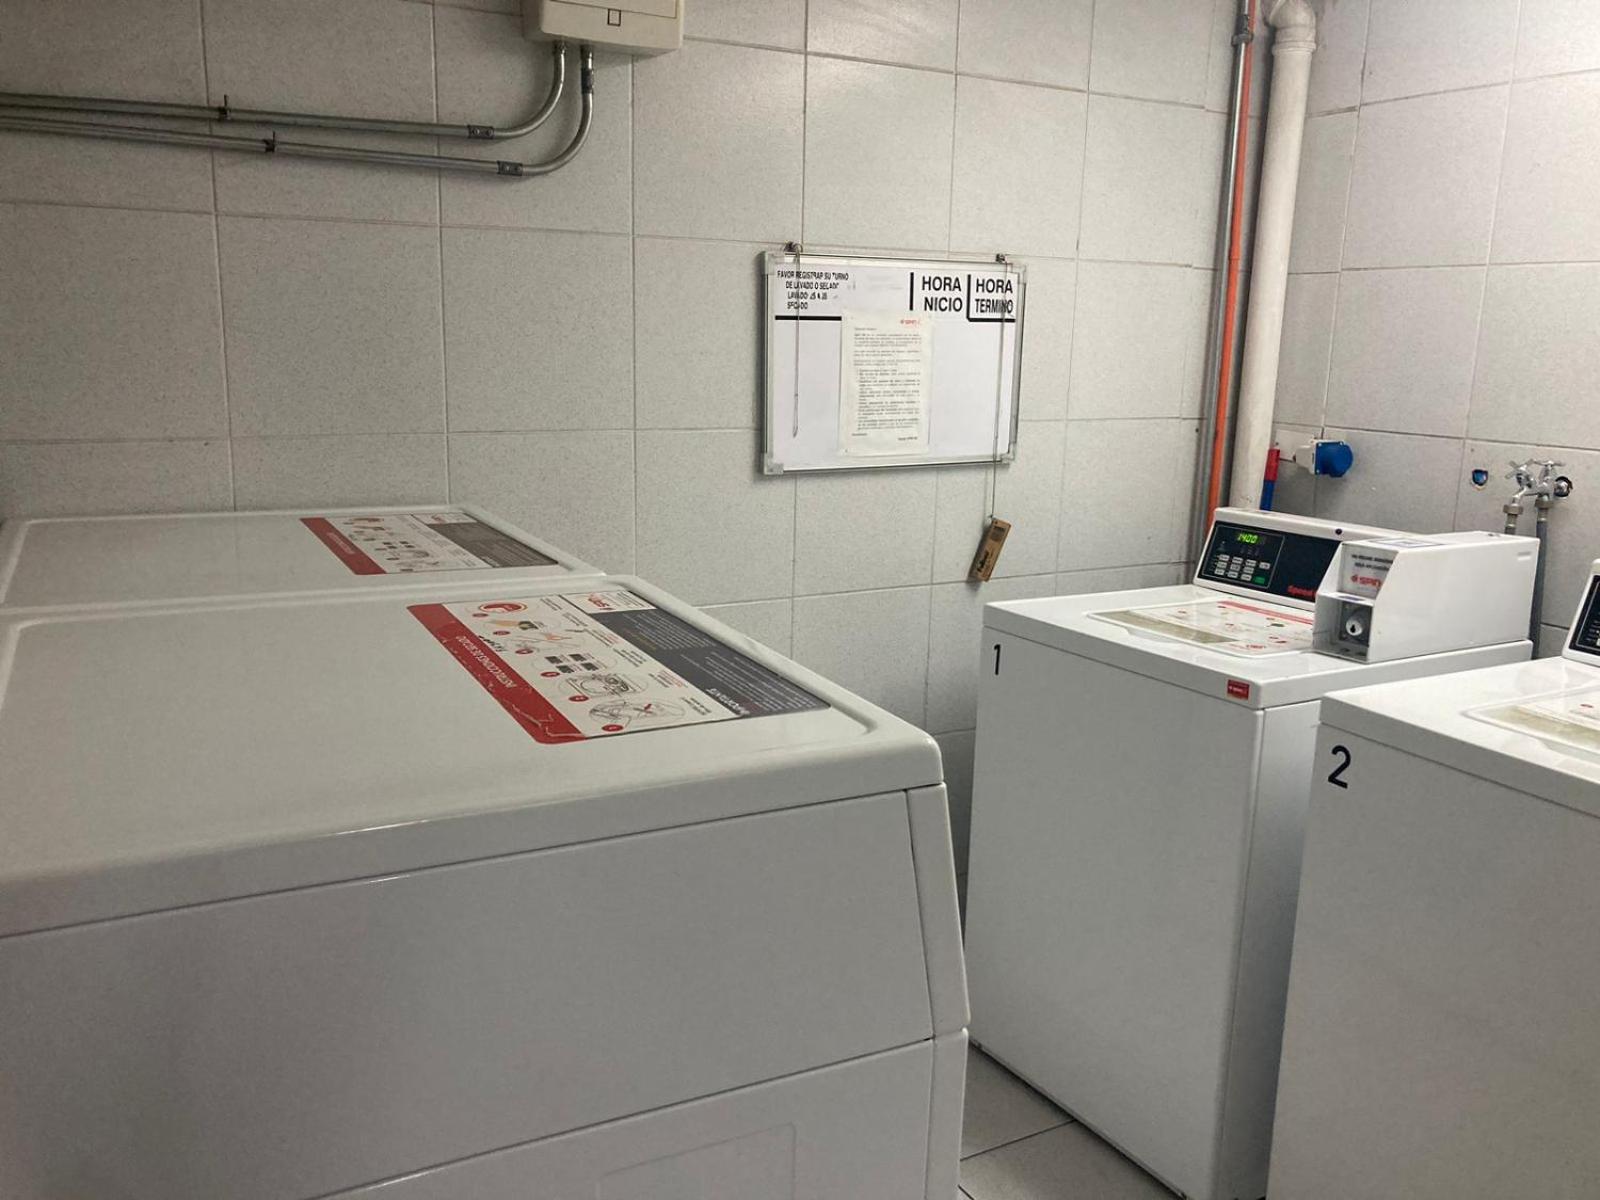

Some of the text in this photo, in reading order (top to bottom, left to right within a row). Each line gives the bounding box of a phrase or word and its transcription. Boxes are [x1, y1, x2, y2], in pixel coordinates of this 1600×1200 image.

[777, 270, 795, 278] FAVOR
[824, 272, 831, 280] SU
[785, 281, 793, 289] DE
[794, 281, 814, 290] LAVADO
[814, 282, 819, 290] O
[922, 275, 962, 292] HORA
[976, 278, 1013, 294] HORA
[974, 298, 1014, 314] TERMINO
[993, 643, 1001, 676] 1
[1327, 744, 1351, 790] 2
